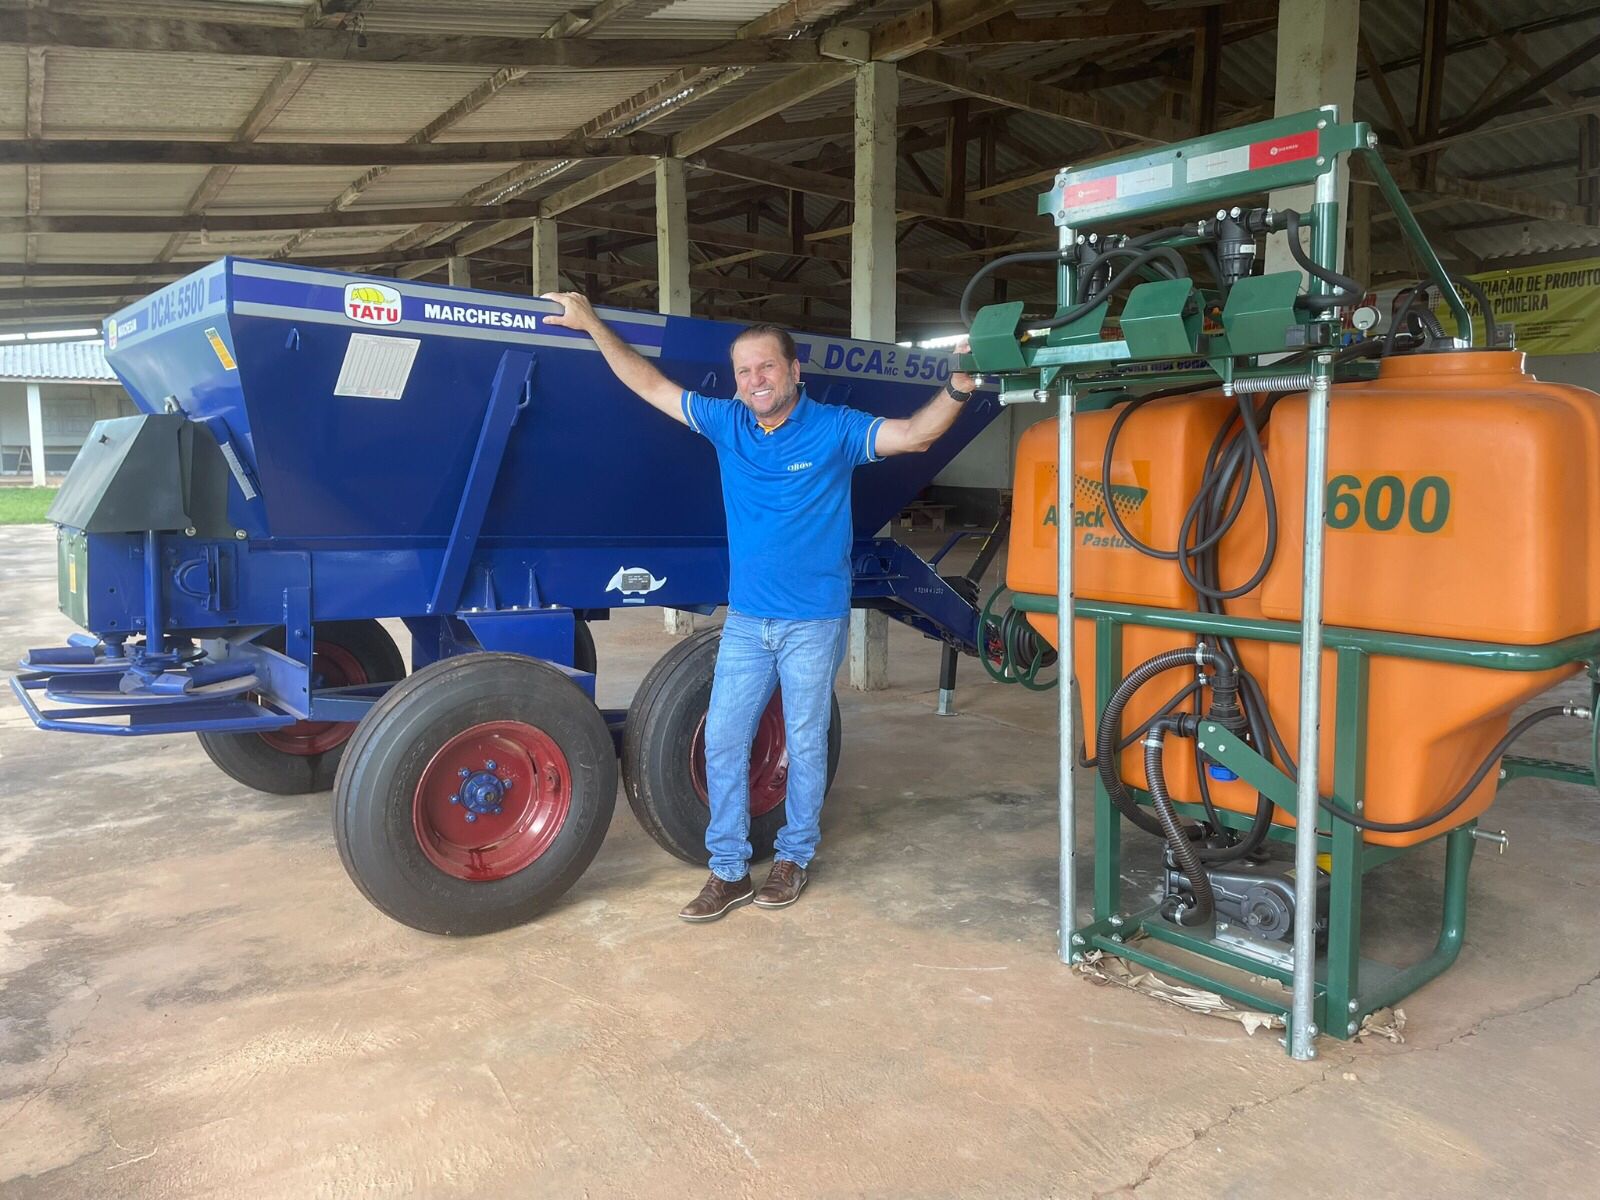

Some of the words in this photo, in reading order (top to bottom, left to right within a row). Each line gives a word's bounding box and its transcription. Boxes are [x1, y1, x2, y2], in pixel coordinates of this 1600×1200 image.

[1526, 275, 1543, 292] DE
[178, 278, 205, 319] 5500
[1495, 294, 1548, 314] PIONEIRA
[349, 303, 398, 322] TATU
[424, 303, 536, 330] MARCHESAN
[884, 366, 899, 376] MC
[904, 353, 949, 382] 550
[1325, 474, 1451, 534] 600
[1042, 505, 1106, 528] Aack
